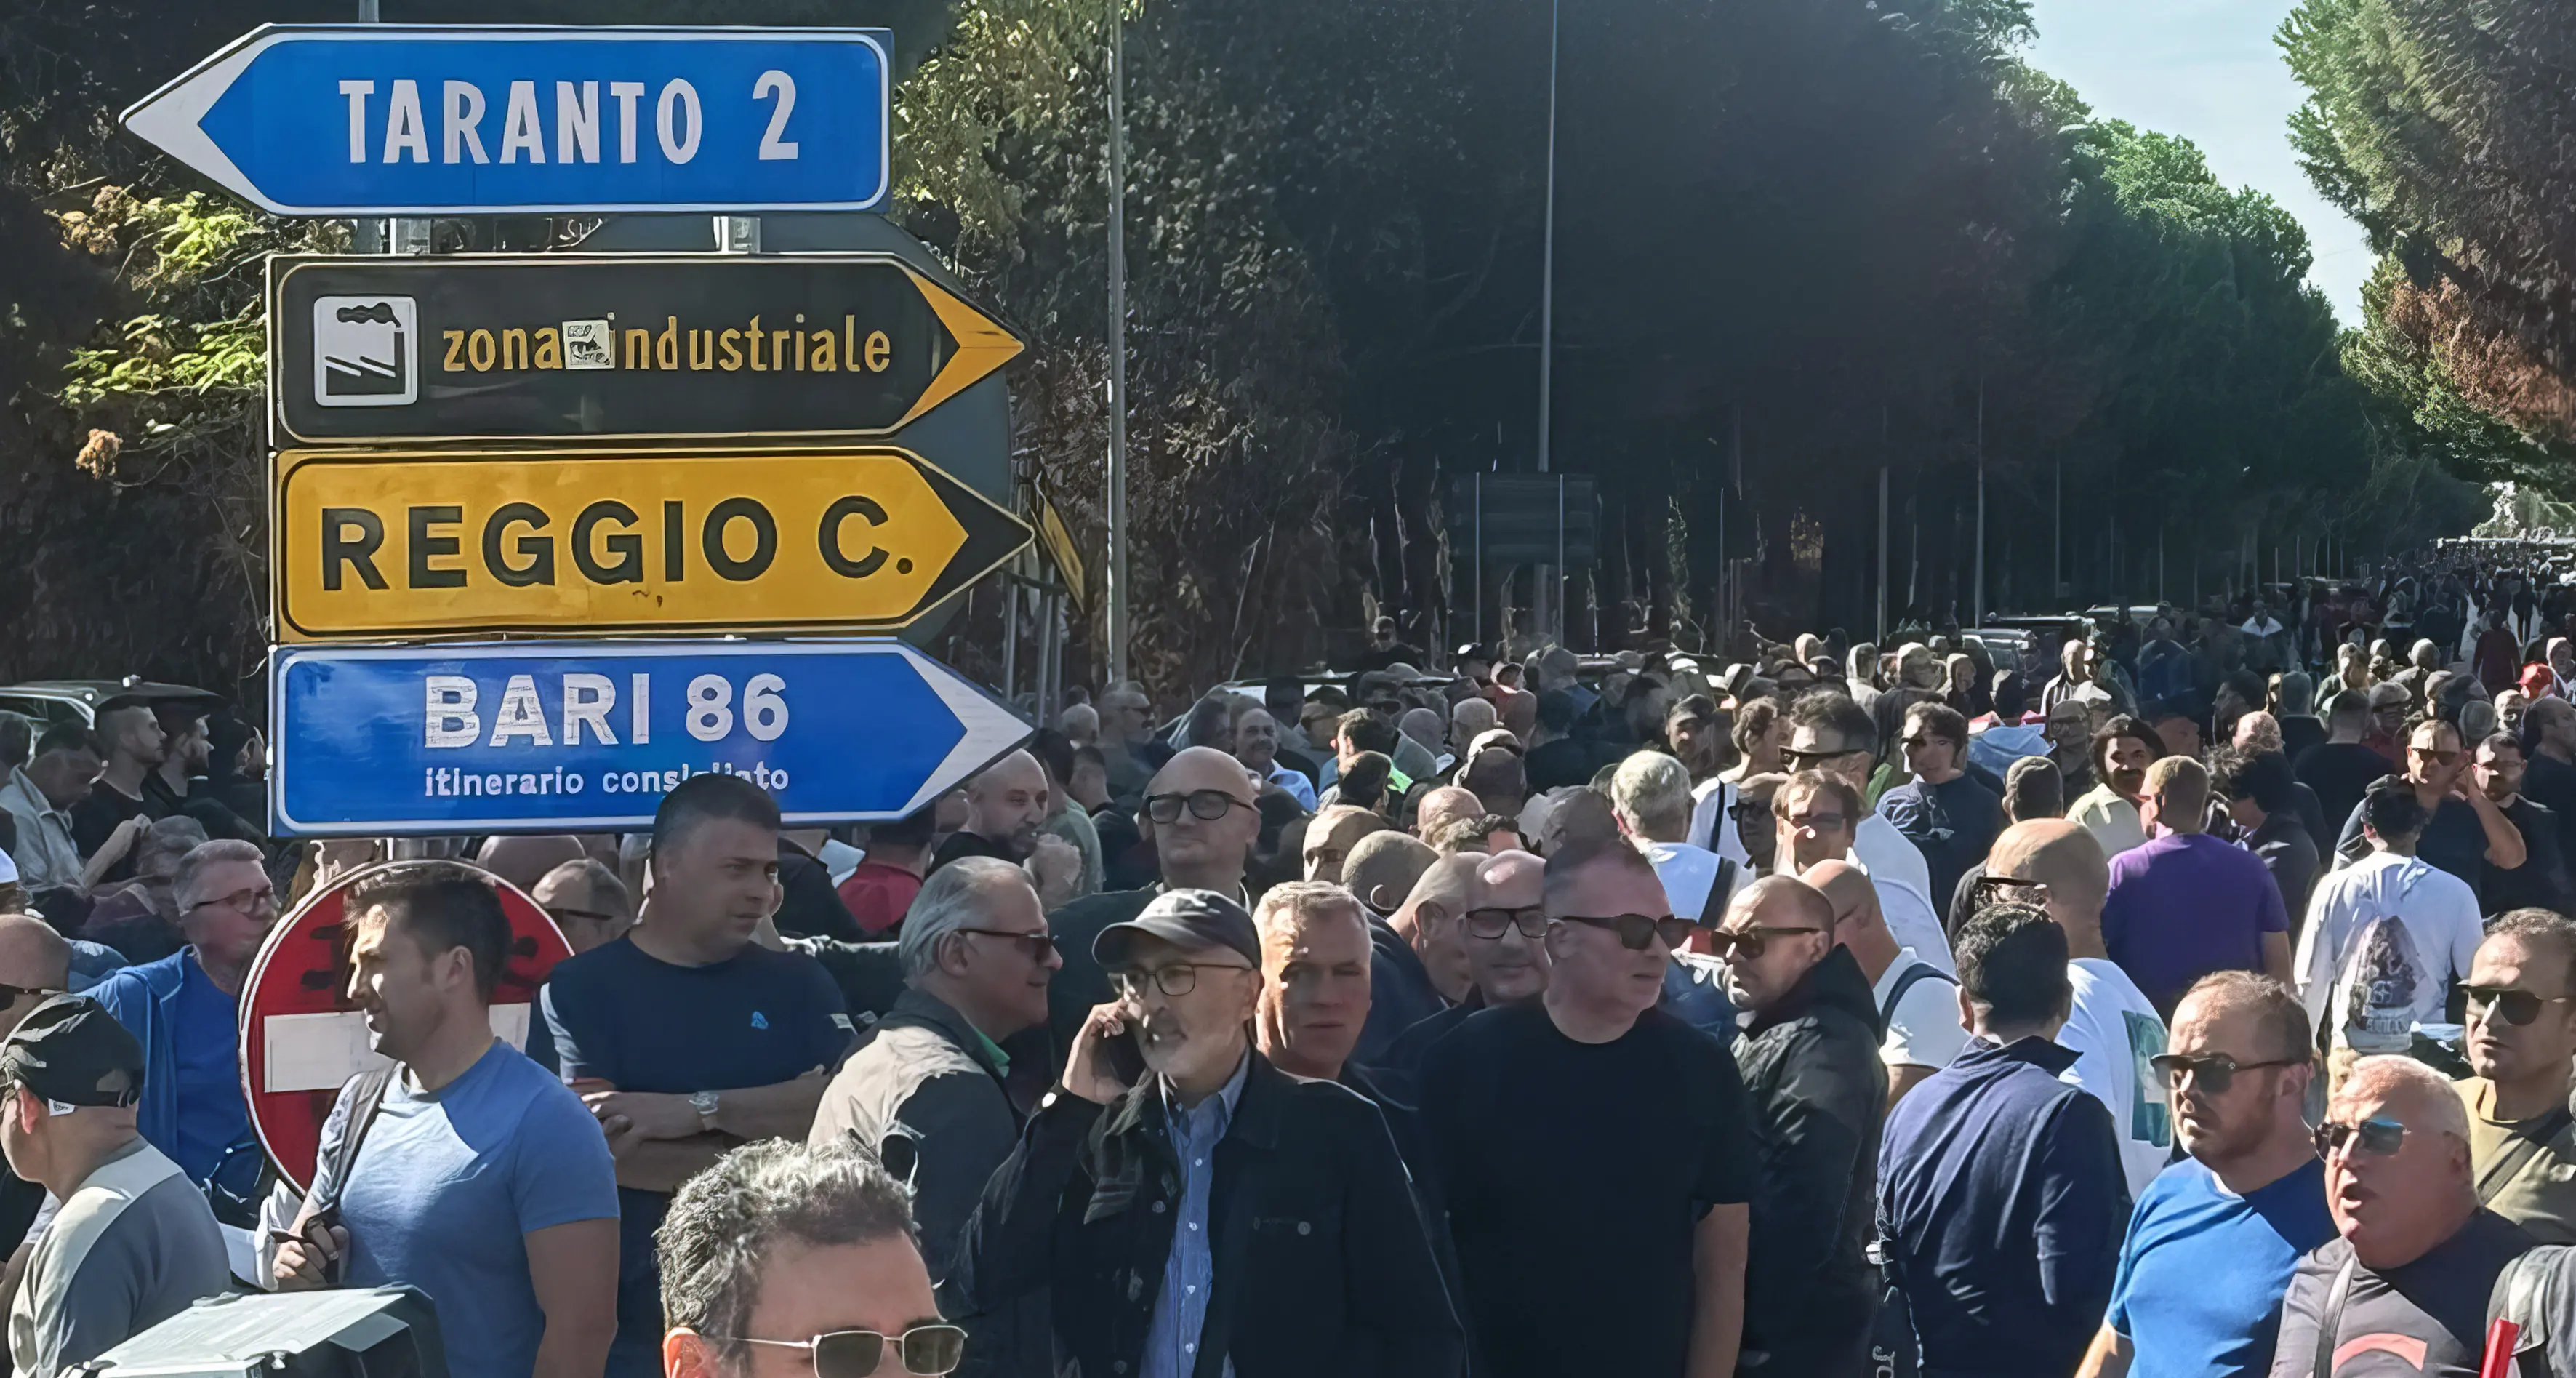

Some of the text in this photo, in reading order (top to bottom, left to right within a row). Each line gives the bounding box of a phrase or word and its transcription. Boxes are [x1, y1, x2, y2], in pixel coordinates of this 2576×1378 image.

[340, 70, 799, 165] TARANTO 2
[443, 327, 563, 372] zona
[608, 311, 891, 373] industriale
[321, 495, 914, 591] REGGIO C.
[425, 673, 790, 748] BARI 86
[425, 761, 790, 796] itinerario consito
